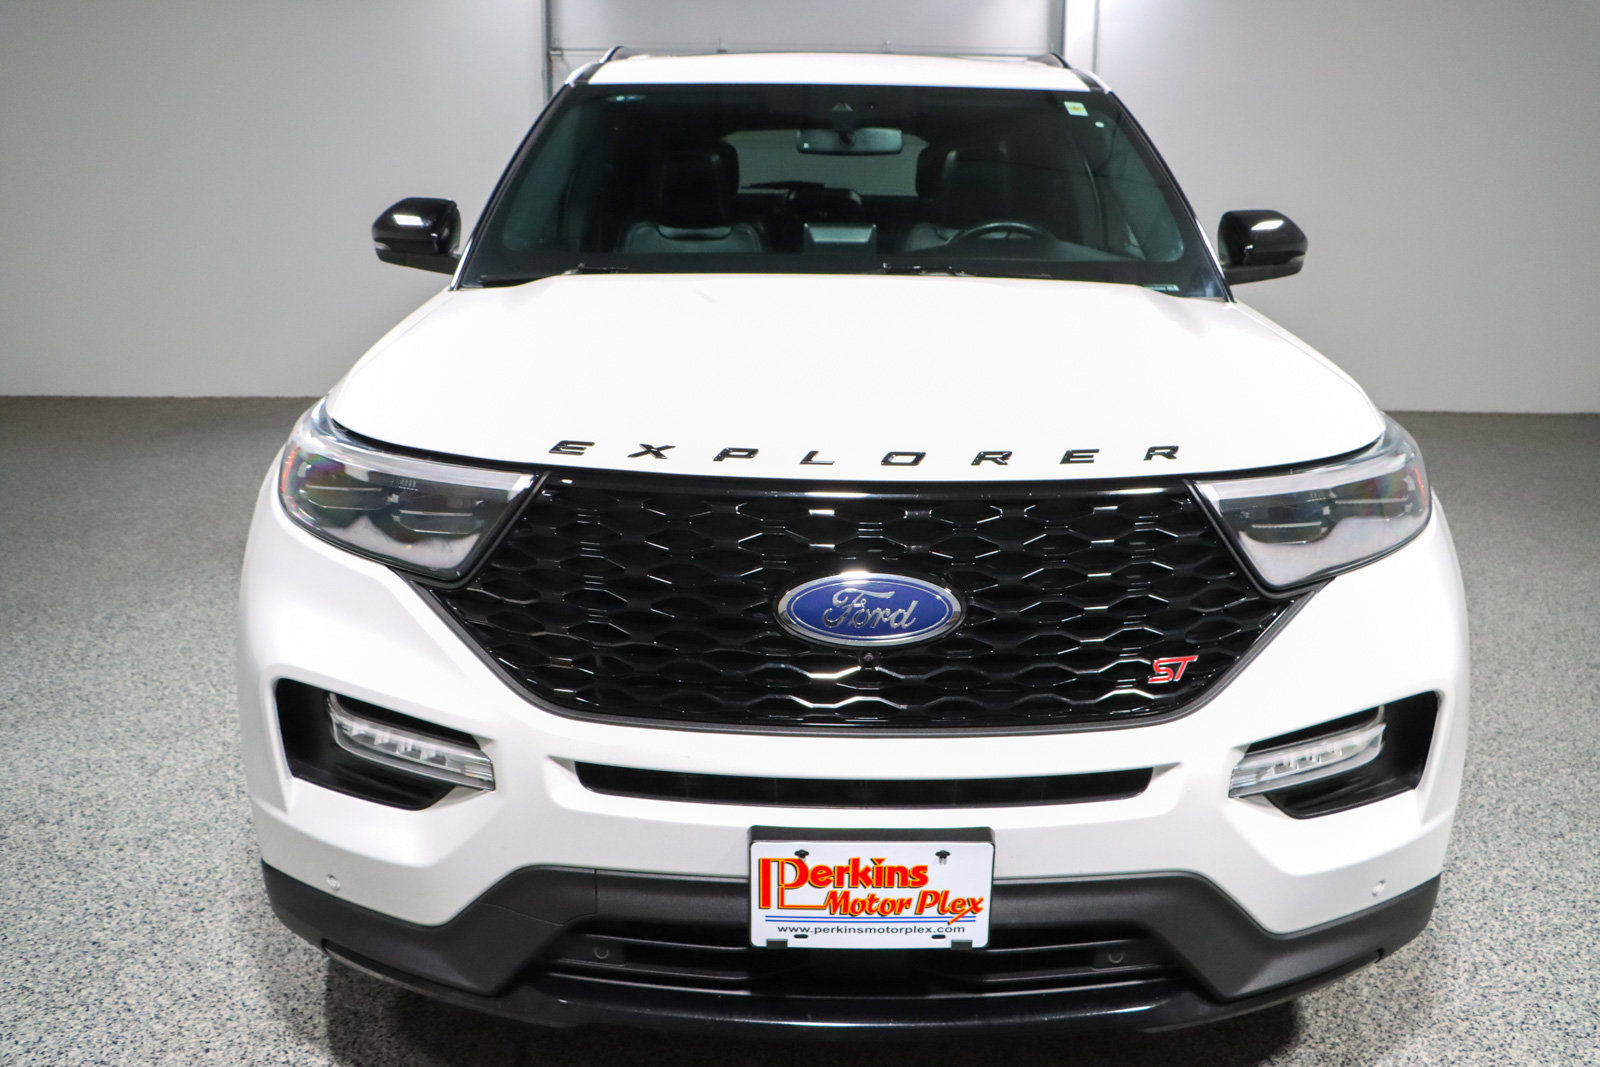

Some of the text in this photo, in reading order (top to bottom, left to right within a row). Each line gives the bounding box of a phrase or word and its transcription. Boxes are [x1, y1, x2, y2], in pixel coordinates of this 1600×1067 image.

[548, 440, 1179, 466] EXPLORER
[822, 587, 918, 629] Ford
[1148, 655, 1198, 684] ST
[759, 857, 929, 908] Perkins
[827, 890, 984, 924] Motor Plex
[777, 925, 965, 935] www.perkinsmotorplex.com
